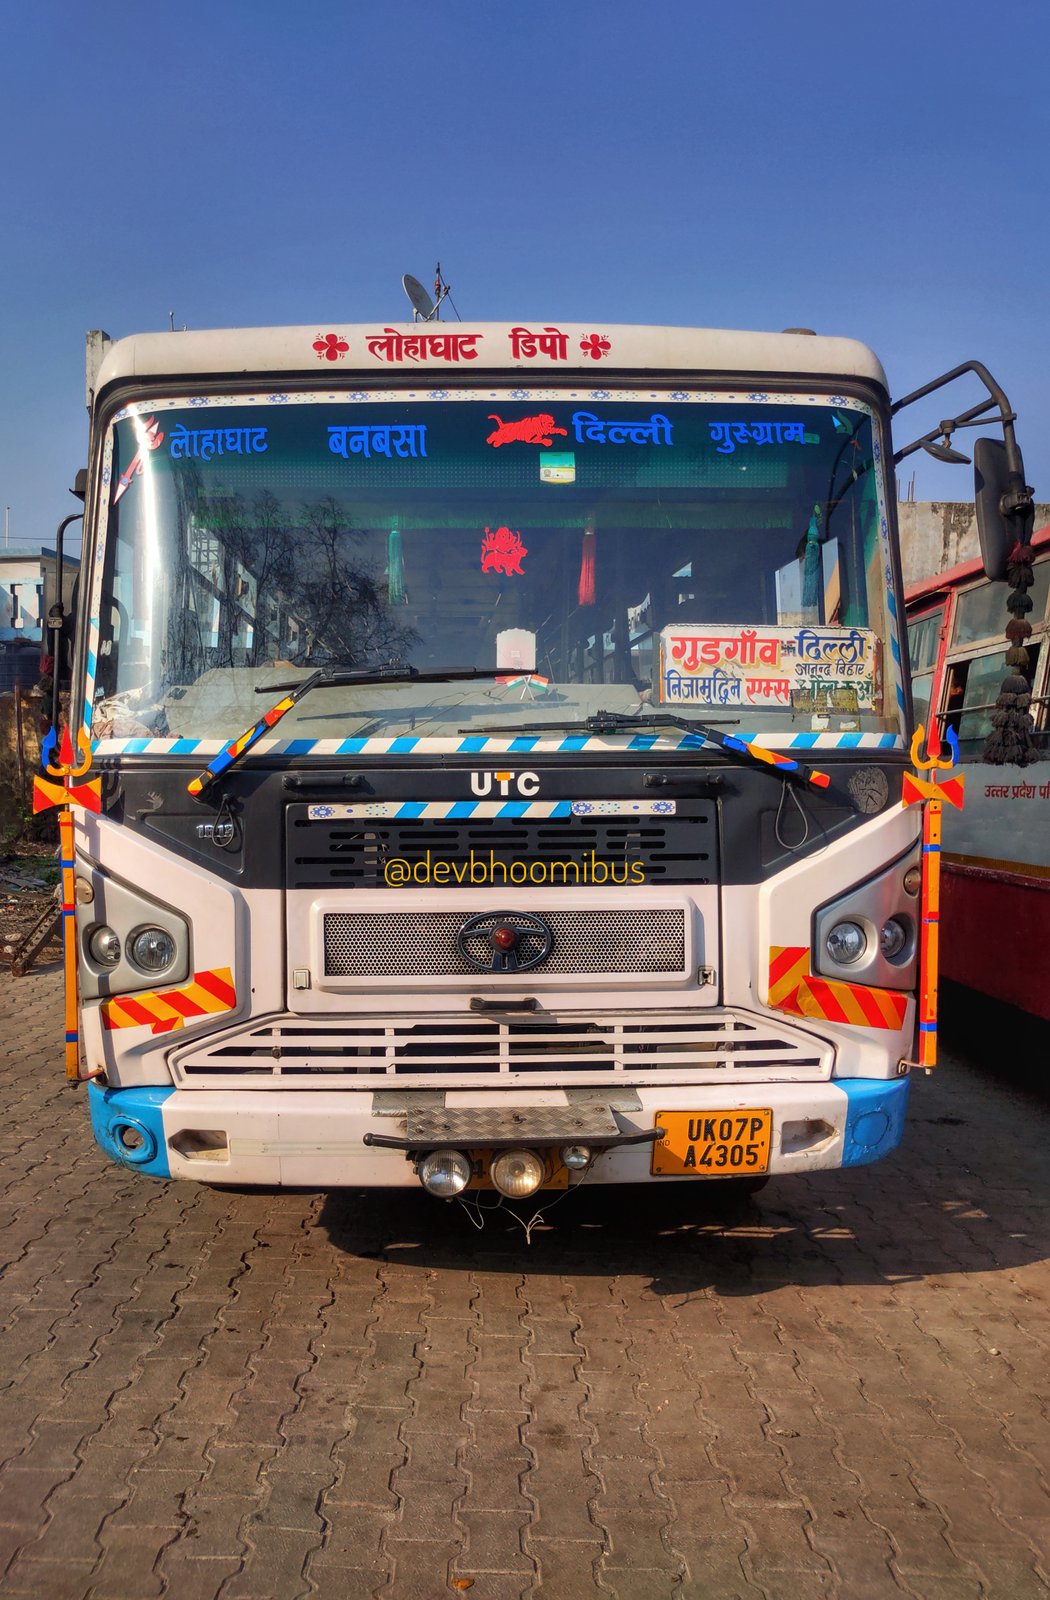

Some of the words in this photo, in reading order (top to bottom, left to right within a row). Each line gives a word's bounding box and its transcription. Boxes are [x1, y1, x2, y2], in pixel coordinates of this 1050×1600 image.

[365, 327, 484, 362] लोहाघाट
[508, 327, 570, 361] डिपो
[327, 424, 428, 459] बनबसा
[572, 411, 674, 446] दिल्ली
[794, 629, 866, 662] दिल्ली
[470, 771, 541, 797] UTC
[984, 785, 1010, 798] उत्तर
[1011, 780, 1037, 800] प्रदेश
[687, 1117, 764, 1142] UK07P
[683, 1143, 760, 1168] A4305
